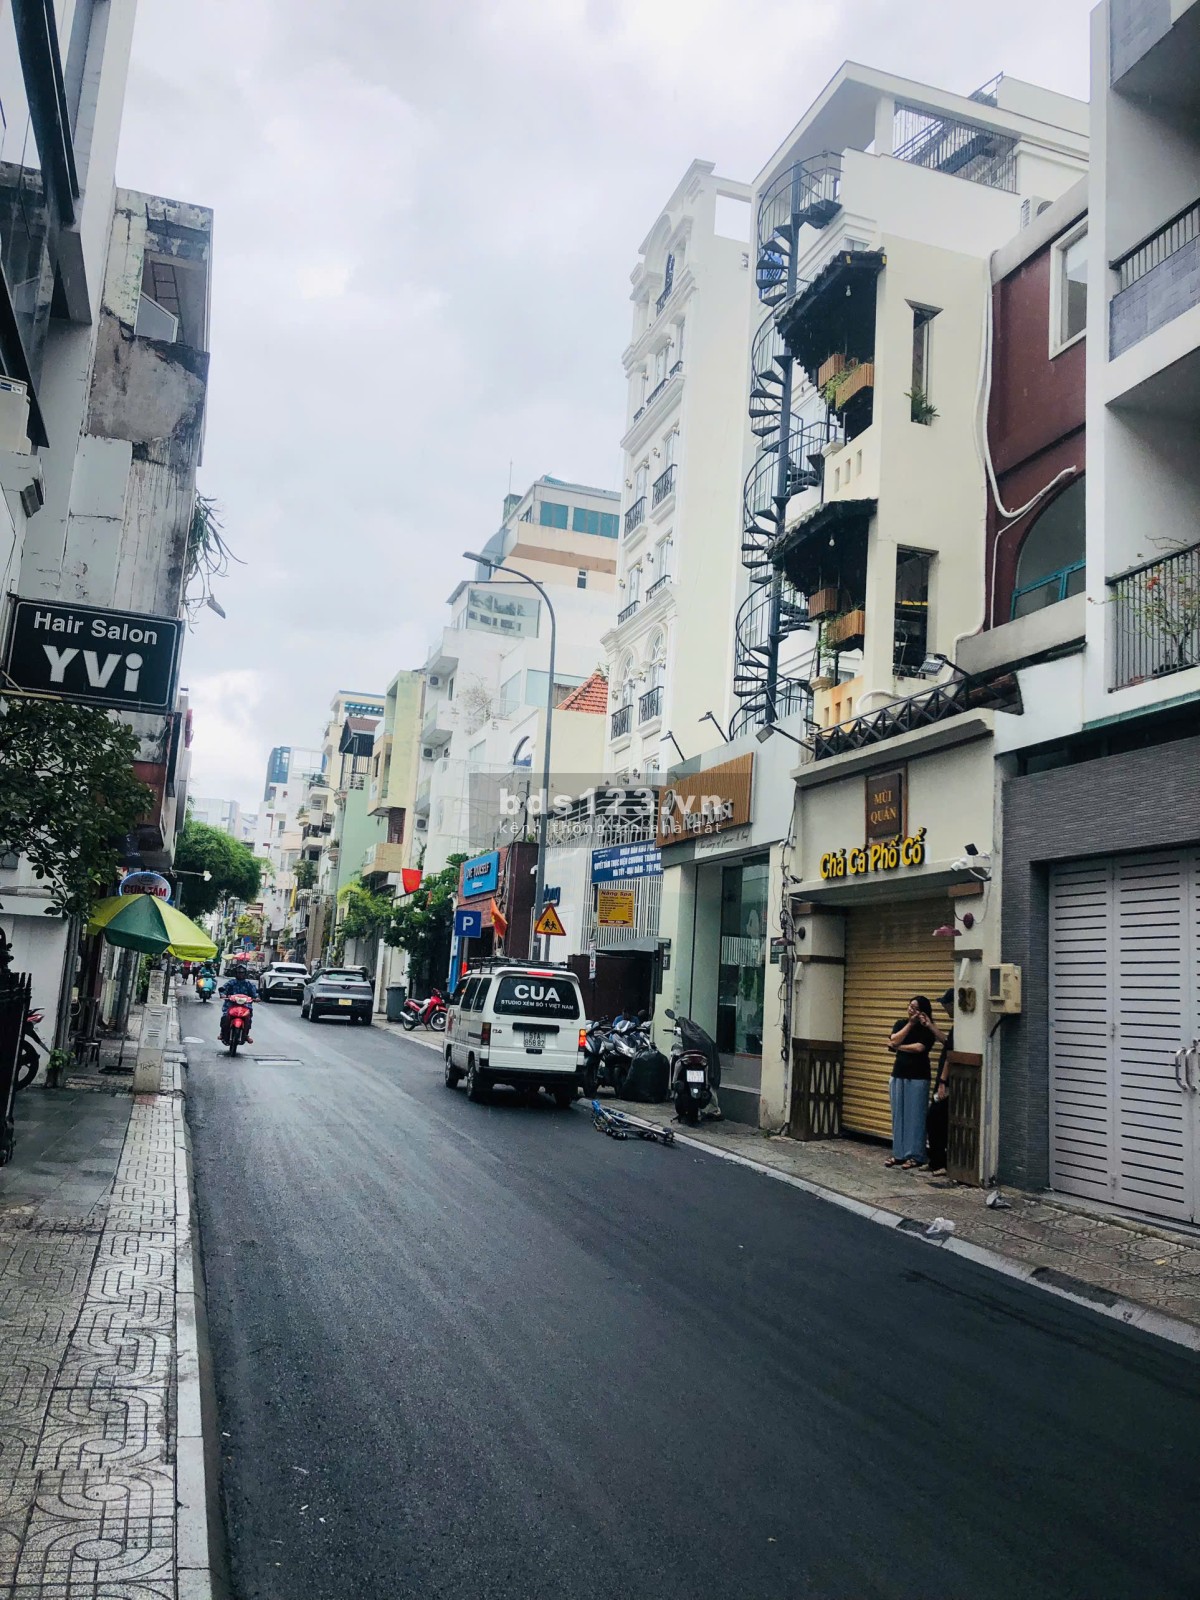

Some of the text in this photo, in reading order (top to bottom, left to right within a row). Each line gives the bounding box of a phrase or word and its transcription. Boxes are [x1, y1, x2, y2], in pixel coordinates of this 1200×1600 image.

[34, 611, 158, 645] Hair Salon
[42, 644, 143, 692] YVi
[870, 806, 897, 824] QUÁN
[820, 827, 927, 879] Chả Cá Phố Cổ
[462, 916, 474, 931] P
[514, 984, 560, 1001] CUA
